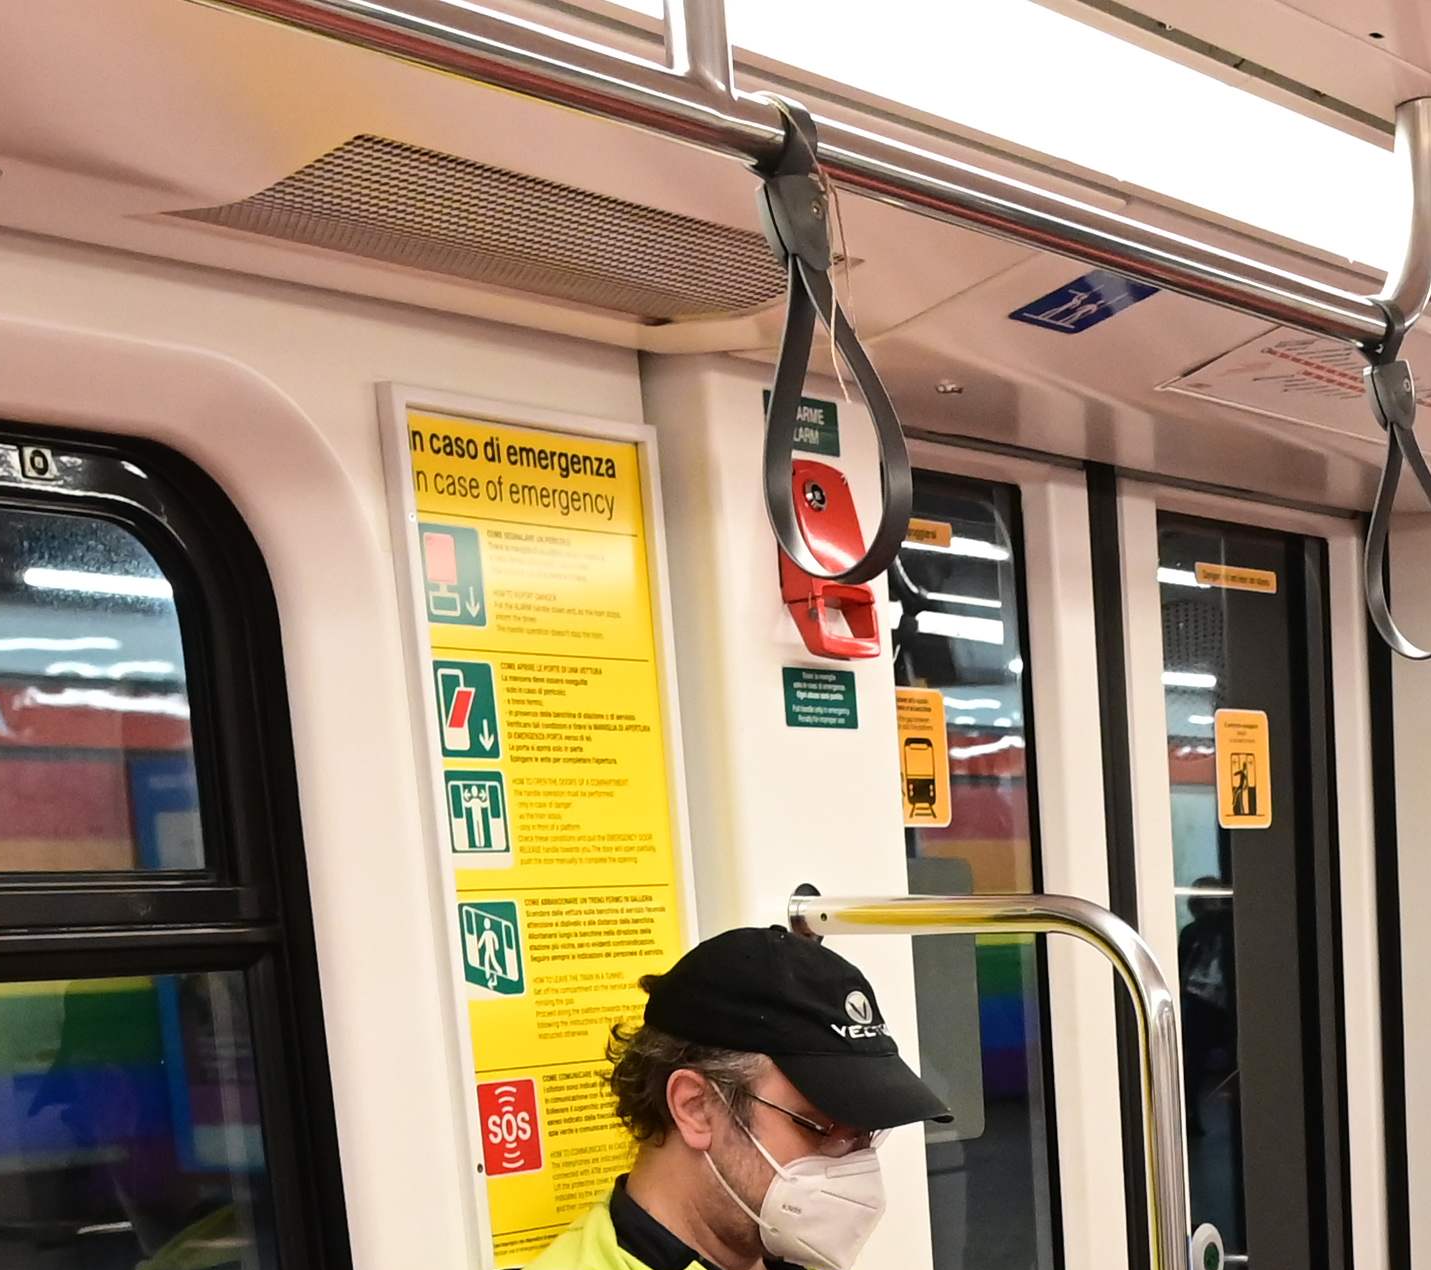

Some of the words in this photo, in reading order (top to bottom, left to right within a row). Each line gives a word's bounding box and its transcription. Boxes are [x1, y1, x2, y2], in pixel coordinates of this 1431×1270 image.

[430, 432, 478, 460] caso
[484, 436, 501, 463] di
[507, 444, 616, 478] emergenza
[434, 472, 479, 499] case
[486, 475, 503, 502] of
[510, 484, 614, 521] emergency
[488, 1112, 532, 1144] SOS
